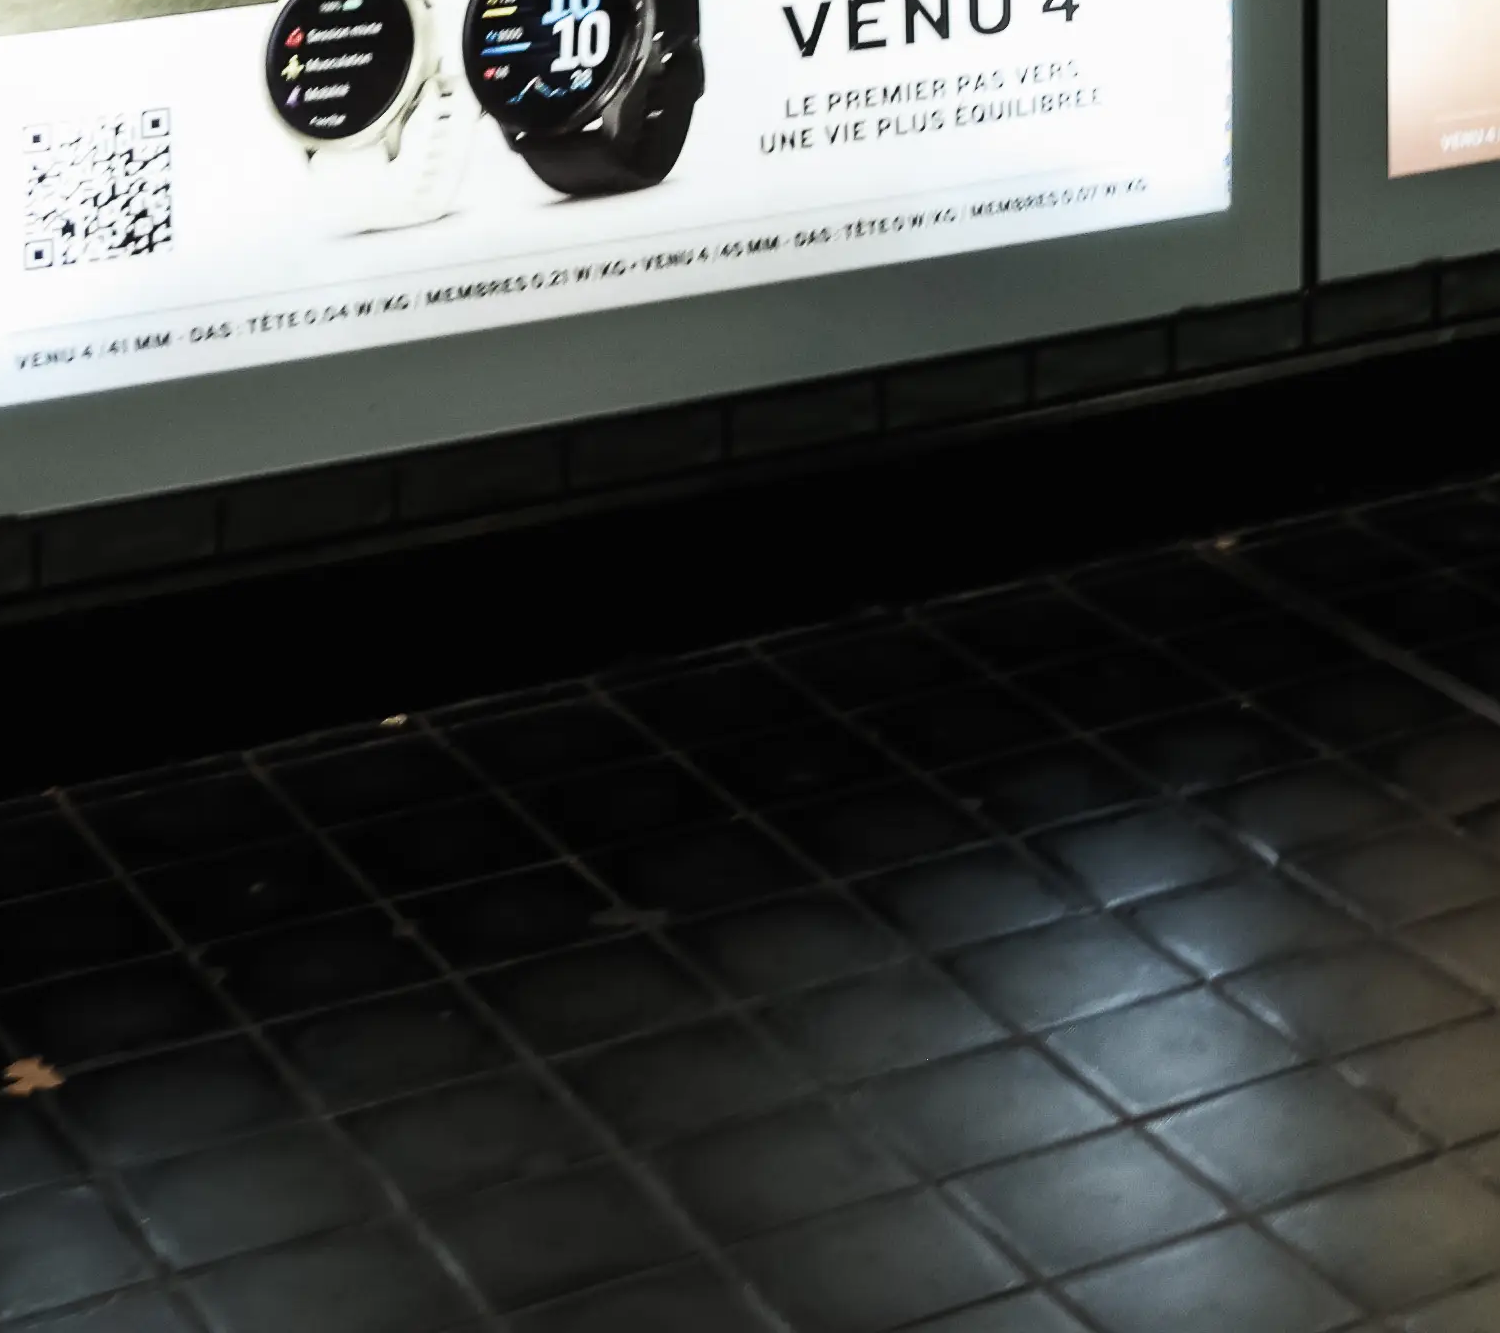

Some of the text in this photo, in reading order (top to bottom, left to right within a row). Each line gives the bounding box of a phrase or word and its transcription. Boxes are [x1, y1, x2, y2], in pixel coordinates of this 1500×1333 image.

[550, 10, 611, 72] 10
[785, 59, 1080, 120] LE PREMIER PAS VERS
[759, 128, 814, 155] UNE
[824, 118, 867, 145] VIE
[877, 109, 946, 138] PLUS
[16, 347, 75, 370] VENU
